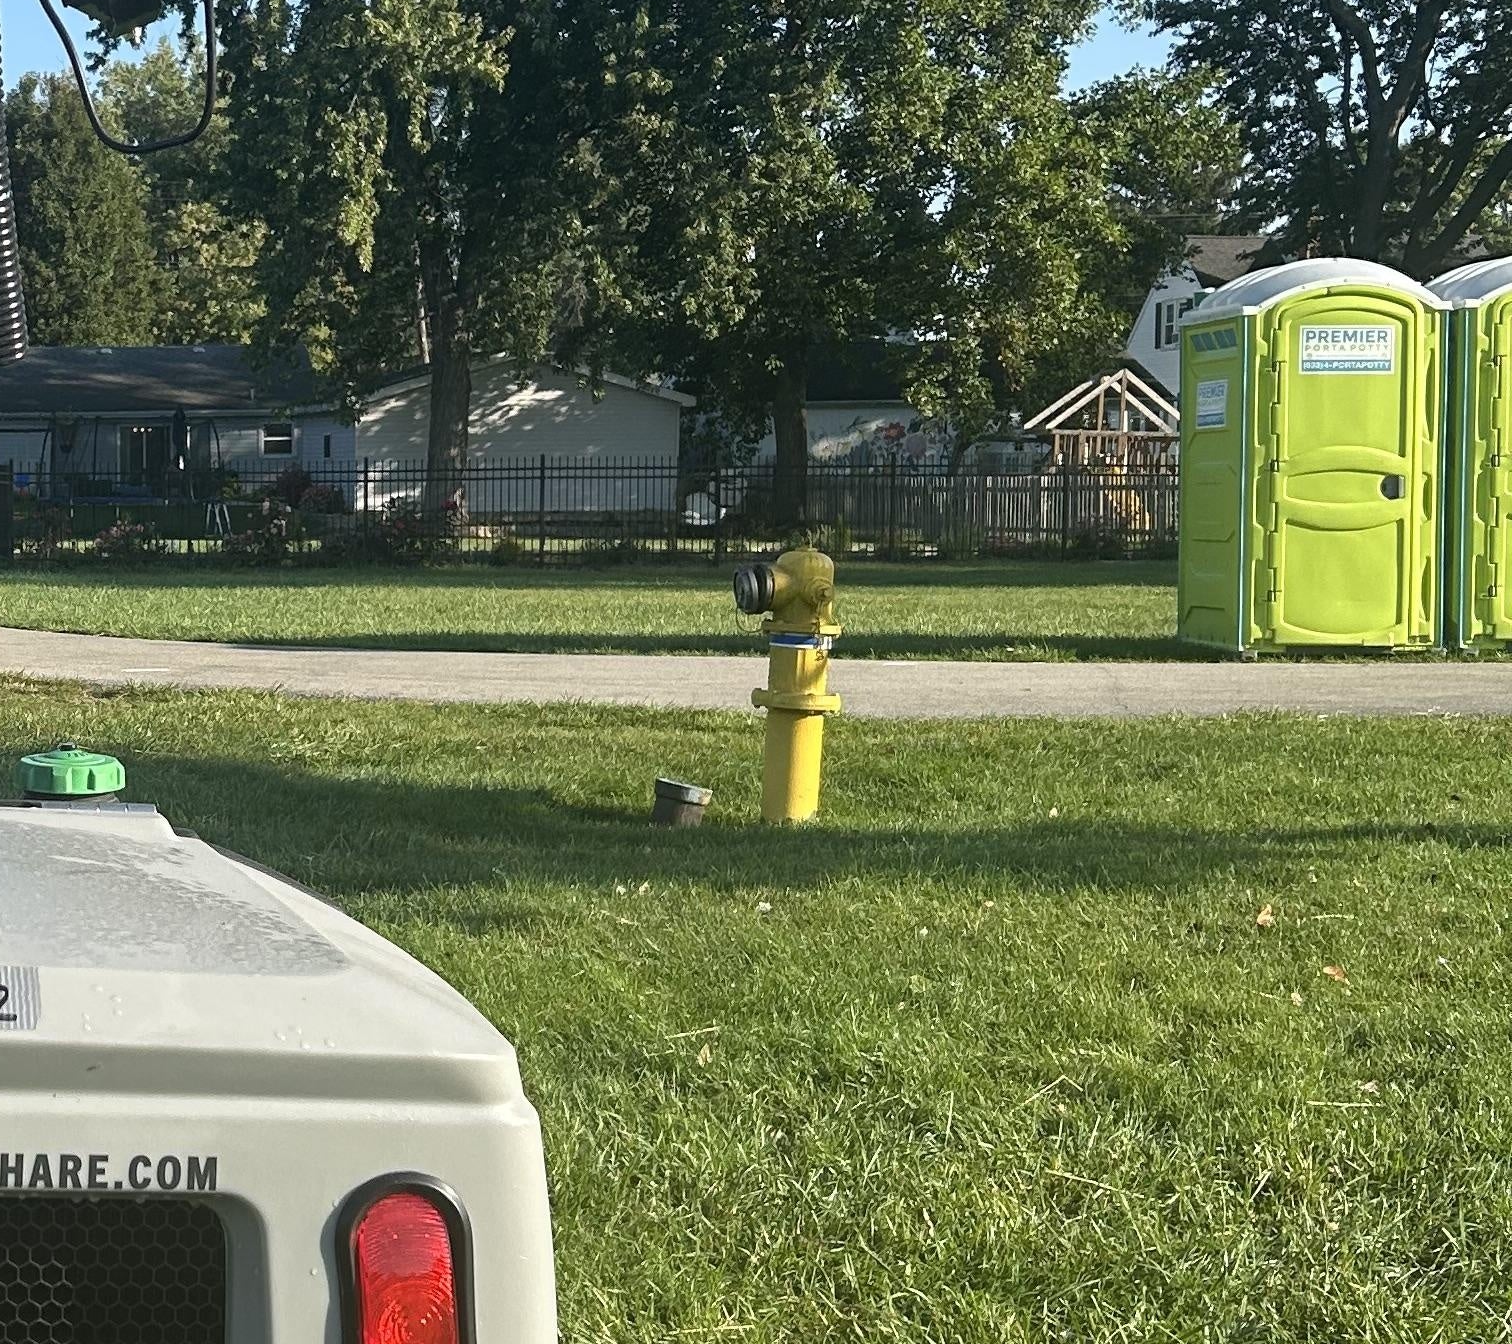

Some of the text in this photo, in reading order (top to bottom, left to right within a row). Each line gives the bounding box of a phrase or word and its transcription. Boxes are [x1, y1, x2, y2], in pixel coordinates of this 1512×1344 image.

[1305, 330, 1388, 343] PREMIER
[1304, 344, 1389, 352] PORTA POTTY
